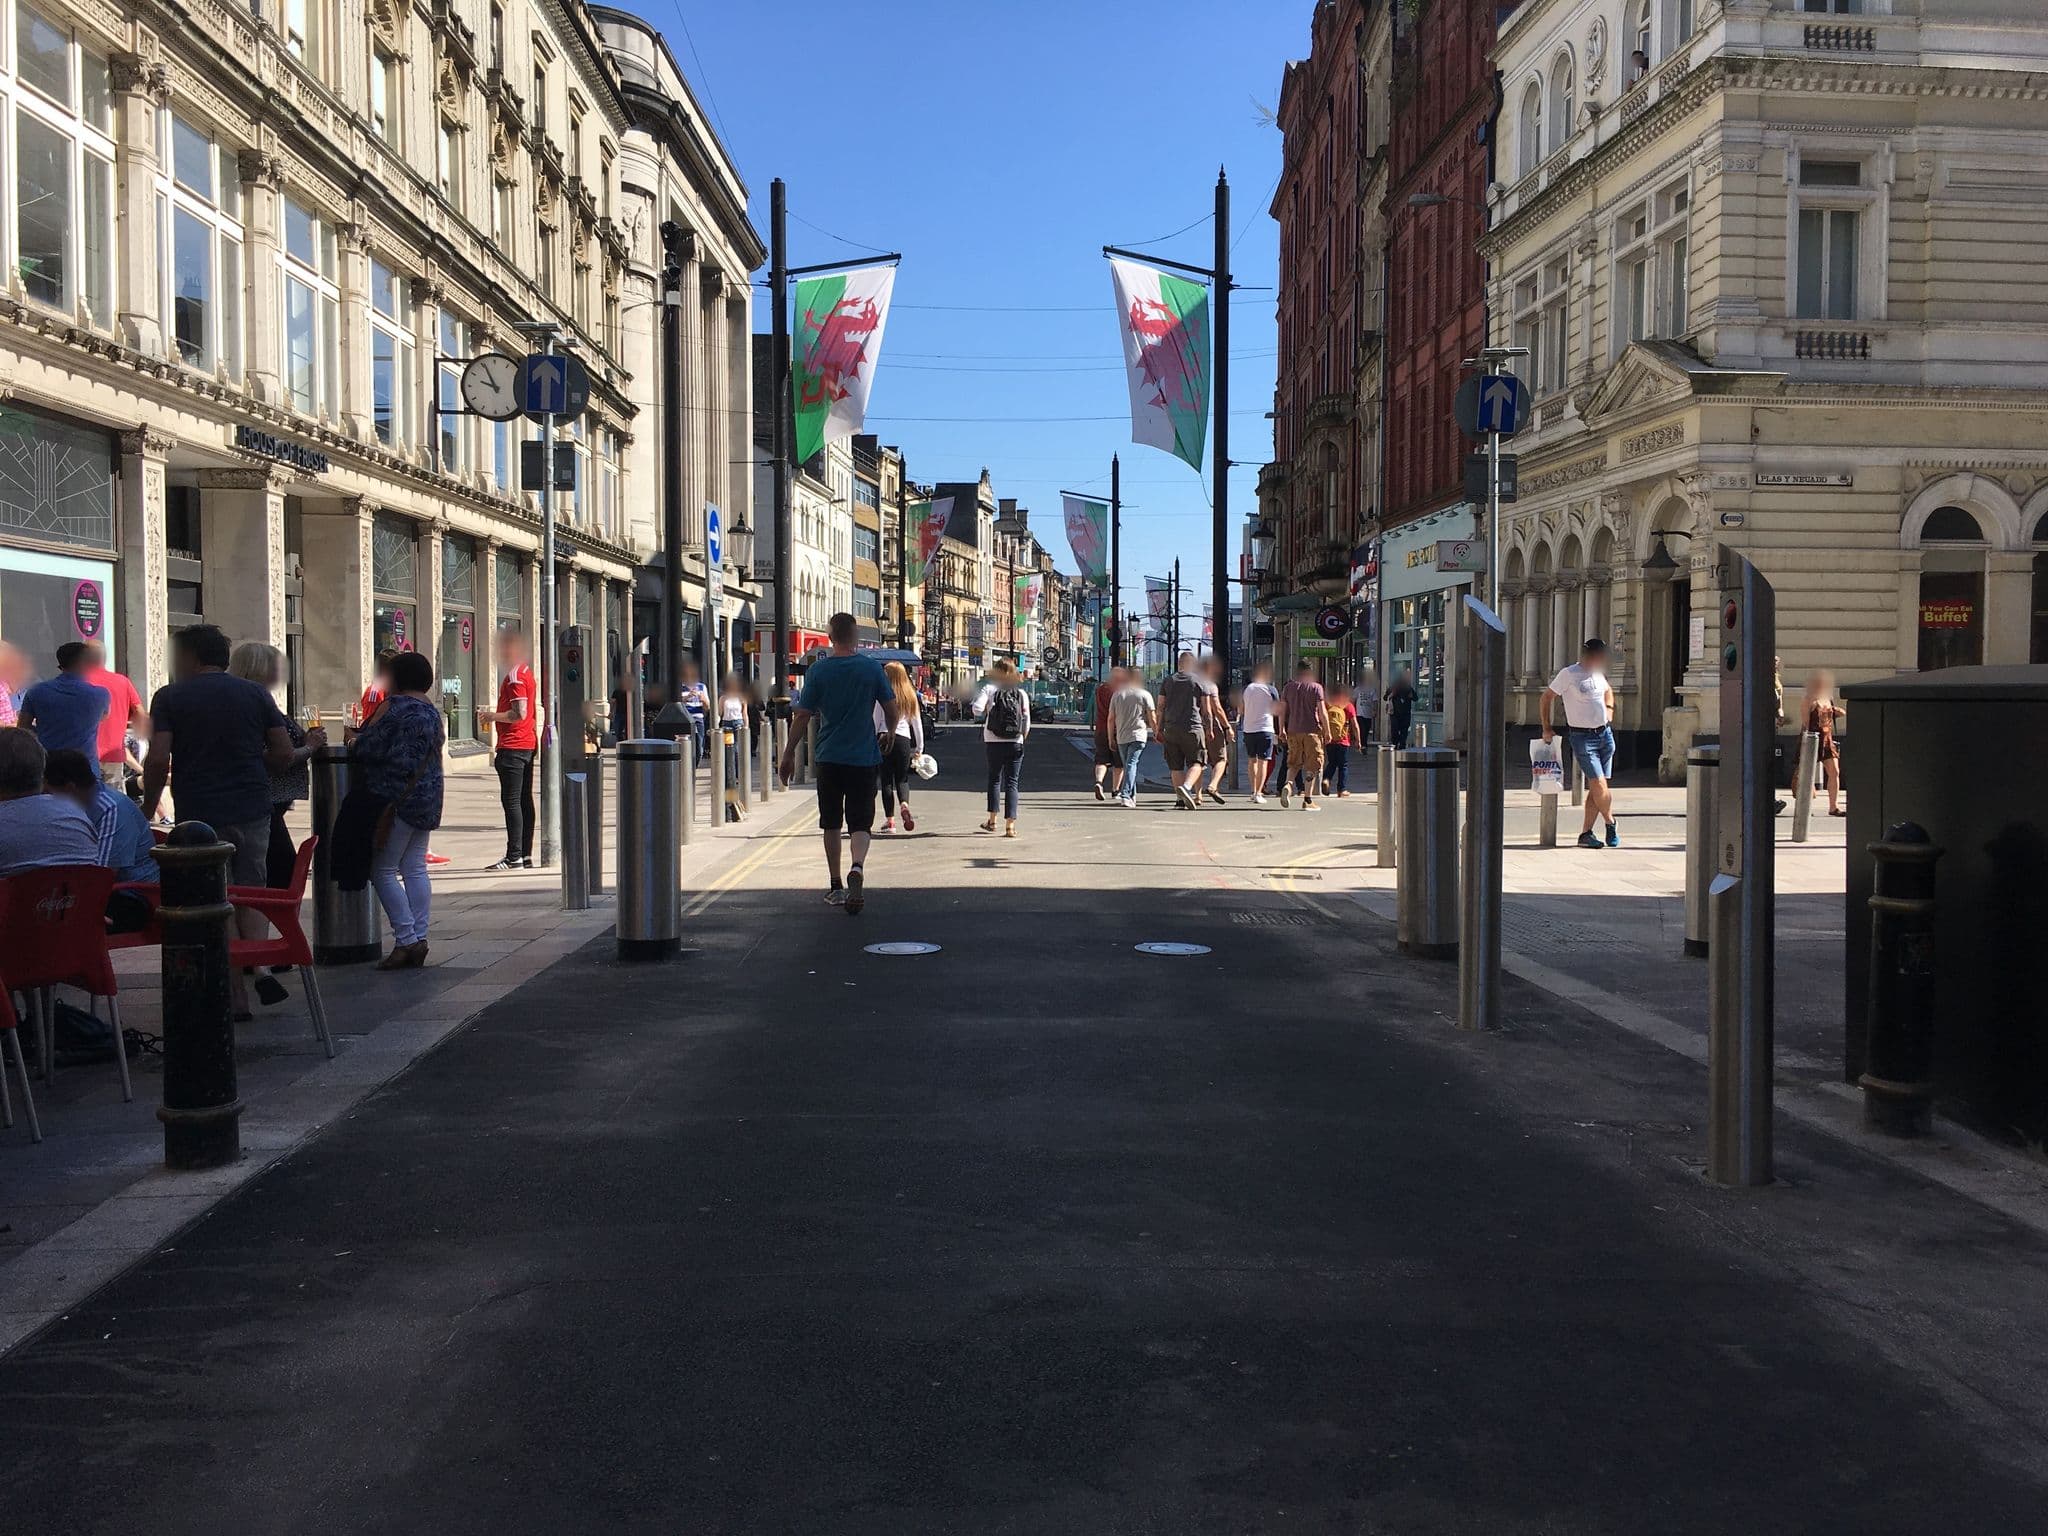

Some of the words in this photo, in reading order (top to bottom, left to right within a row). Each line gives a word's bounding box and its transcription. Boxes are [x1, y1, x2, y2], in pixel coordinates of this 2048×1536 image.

[242, 426, 280, 458] HOUSE
[281, 440, 296, 462] OF
[296, 444, 329, 473] FRASER
[1760, 475, 1783, 483] PLAS
[1924, 611, 1969, 622] Buffet
